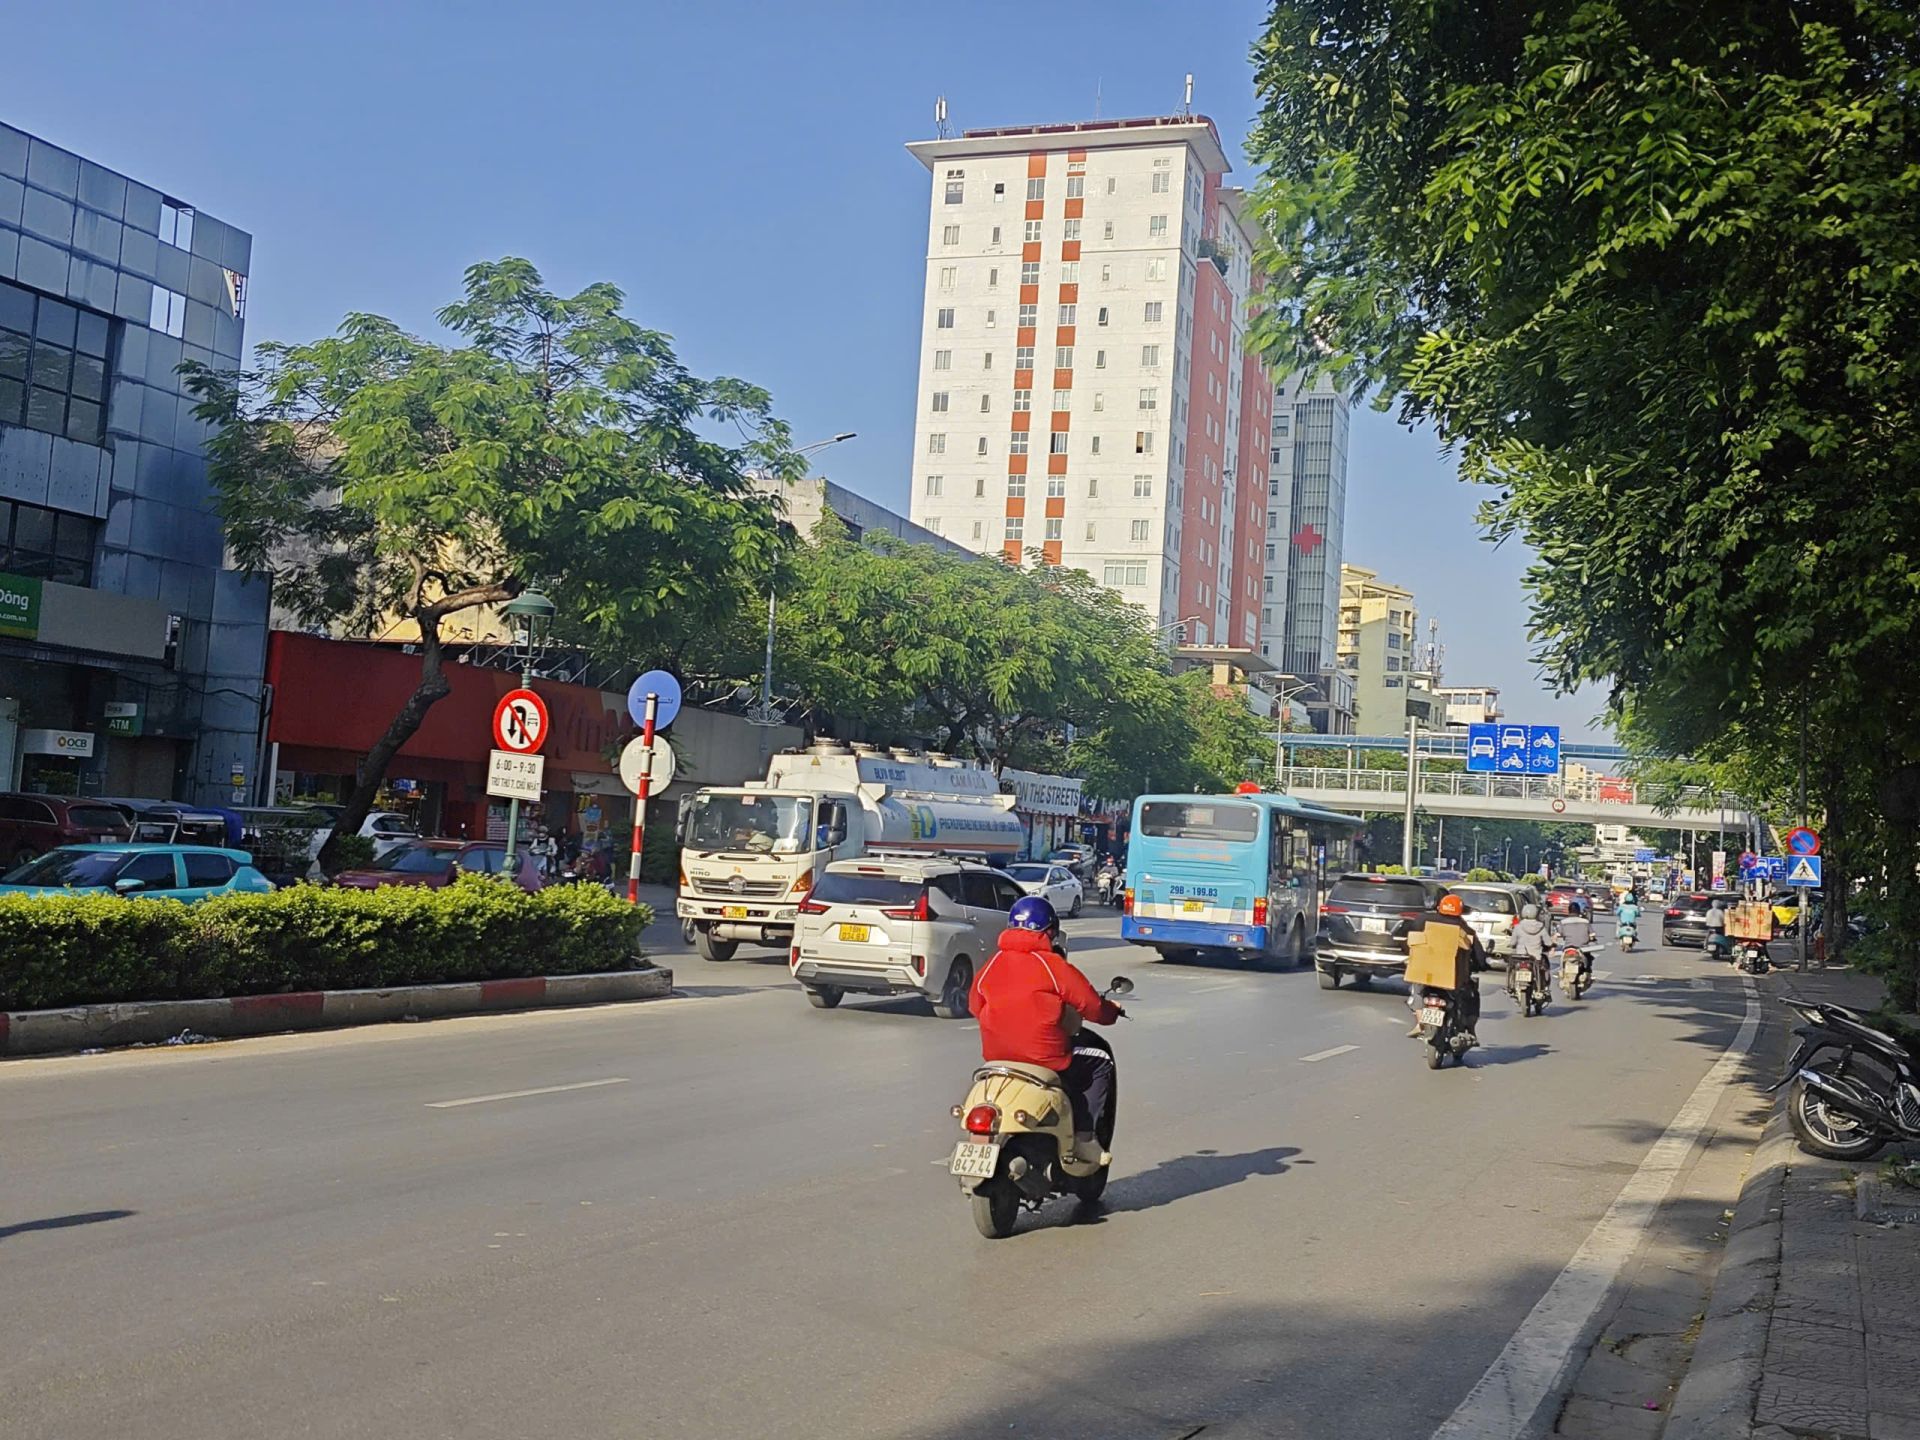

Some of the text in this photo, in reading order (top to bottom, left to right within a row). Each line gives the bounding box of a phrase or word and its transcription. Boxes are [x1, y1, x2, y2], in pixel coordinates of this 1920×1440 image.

[0, 613, 27, 622] .com.vn
[108, 719, 130, 730] ATM
[67, 738, 87, 748] OCB
[496, 759, 512, 771] 6:00
[519, 761, 536, 774] 9:30
[1016, 781, 1028, 801] ON
[1030, 783, 1046, 804] THE
[1046, 785, 1079, 807] STREETS
[1170, 885, 1185, 895] 29B
[961, 1144, 993, 1160] 29-AB
[954, 1159, 991, 1175] 847.44
